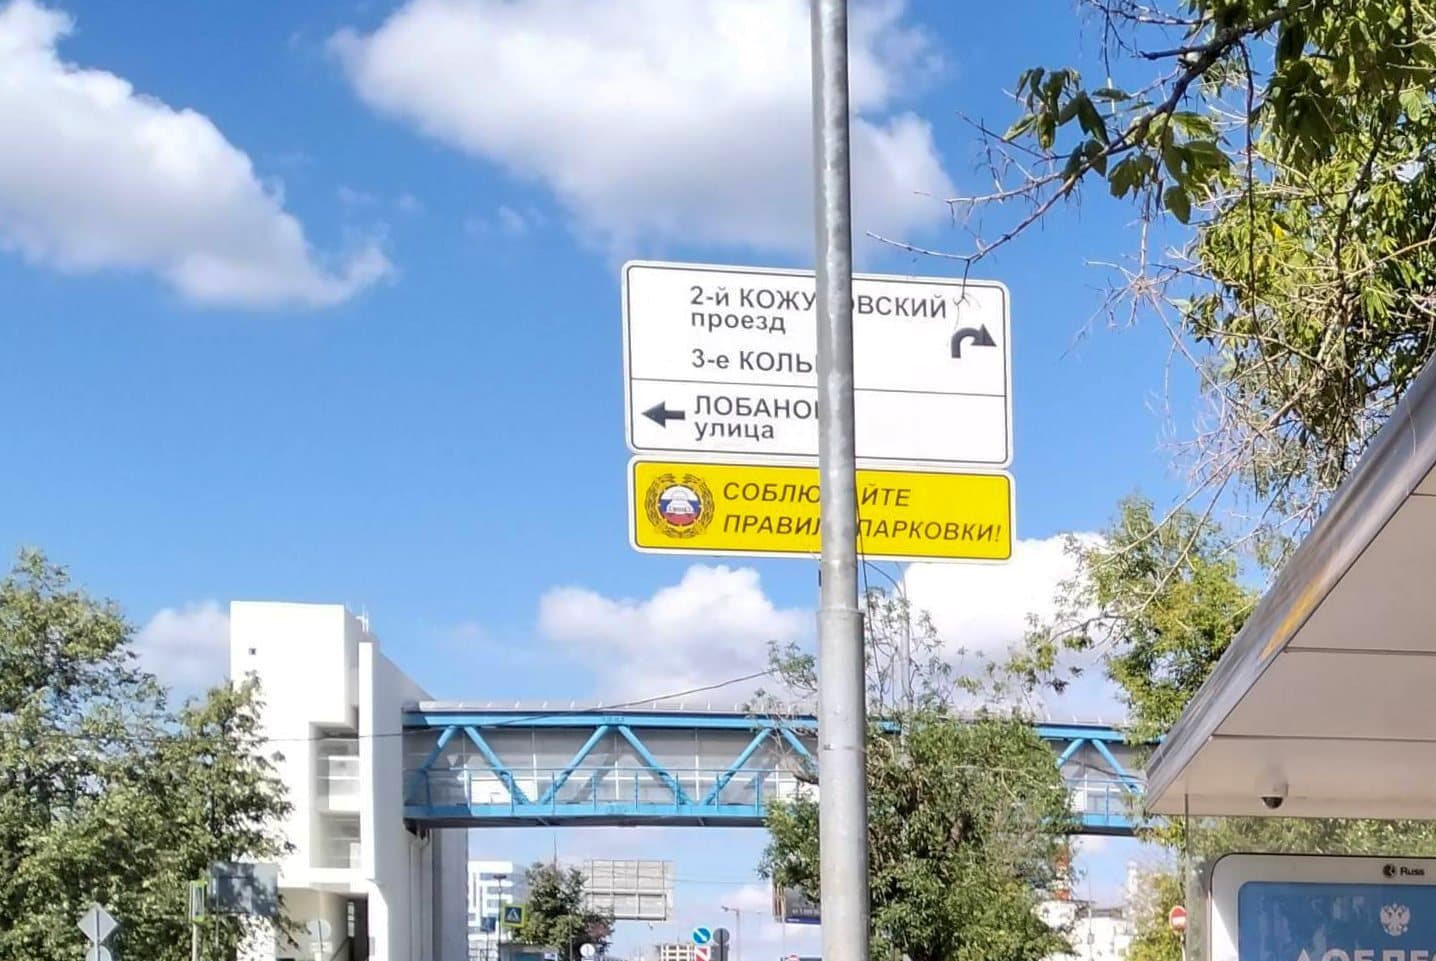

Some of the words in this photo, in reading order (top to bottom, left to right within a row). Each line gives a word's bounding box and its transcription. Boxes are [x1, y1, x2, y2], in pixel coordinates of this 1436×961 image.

[690, 286, 729, 307] 2-й
[740, 287, 946, 318] КОЖУВСКИЙ
[691, 312, 786, 334] проезд
[691, 348, 729, 368] 3-е
[740, 350, 818, 373] КОЛЬ
[694, 395, 819, 420] ЛОБАНО
[694, 421, 775, 441] улица
[723, 482, 911, 508] СОБЛЮЙТЕ
[857, 518, 1001, 542] ПАРКОВКИ!
